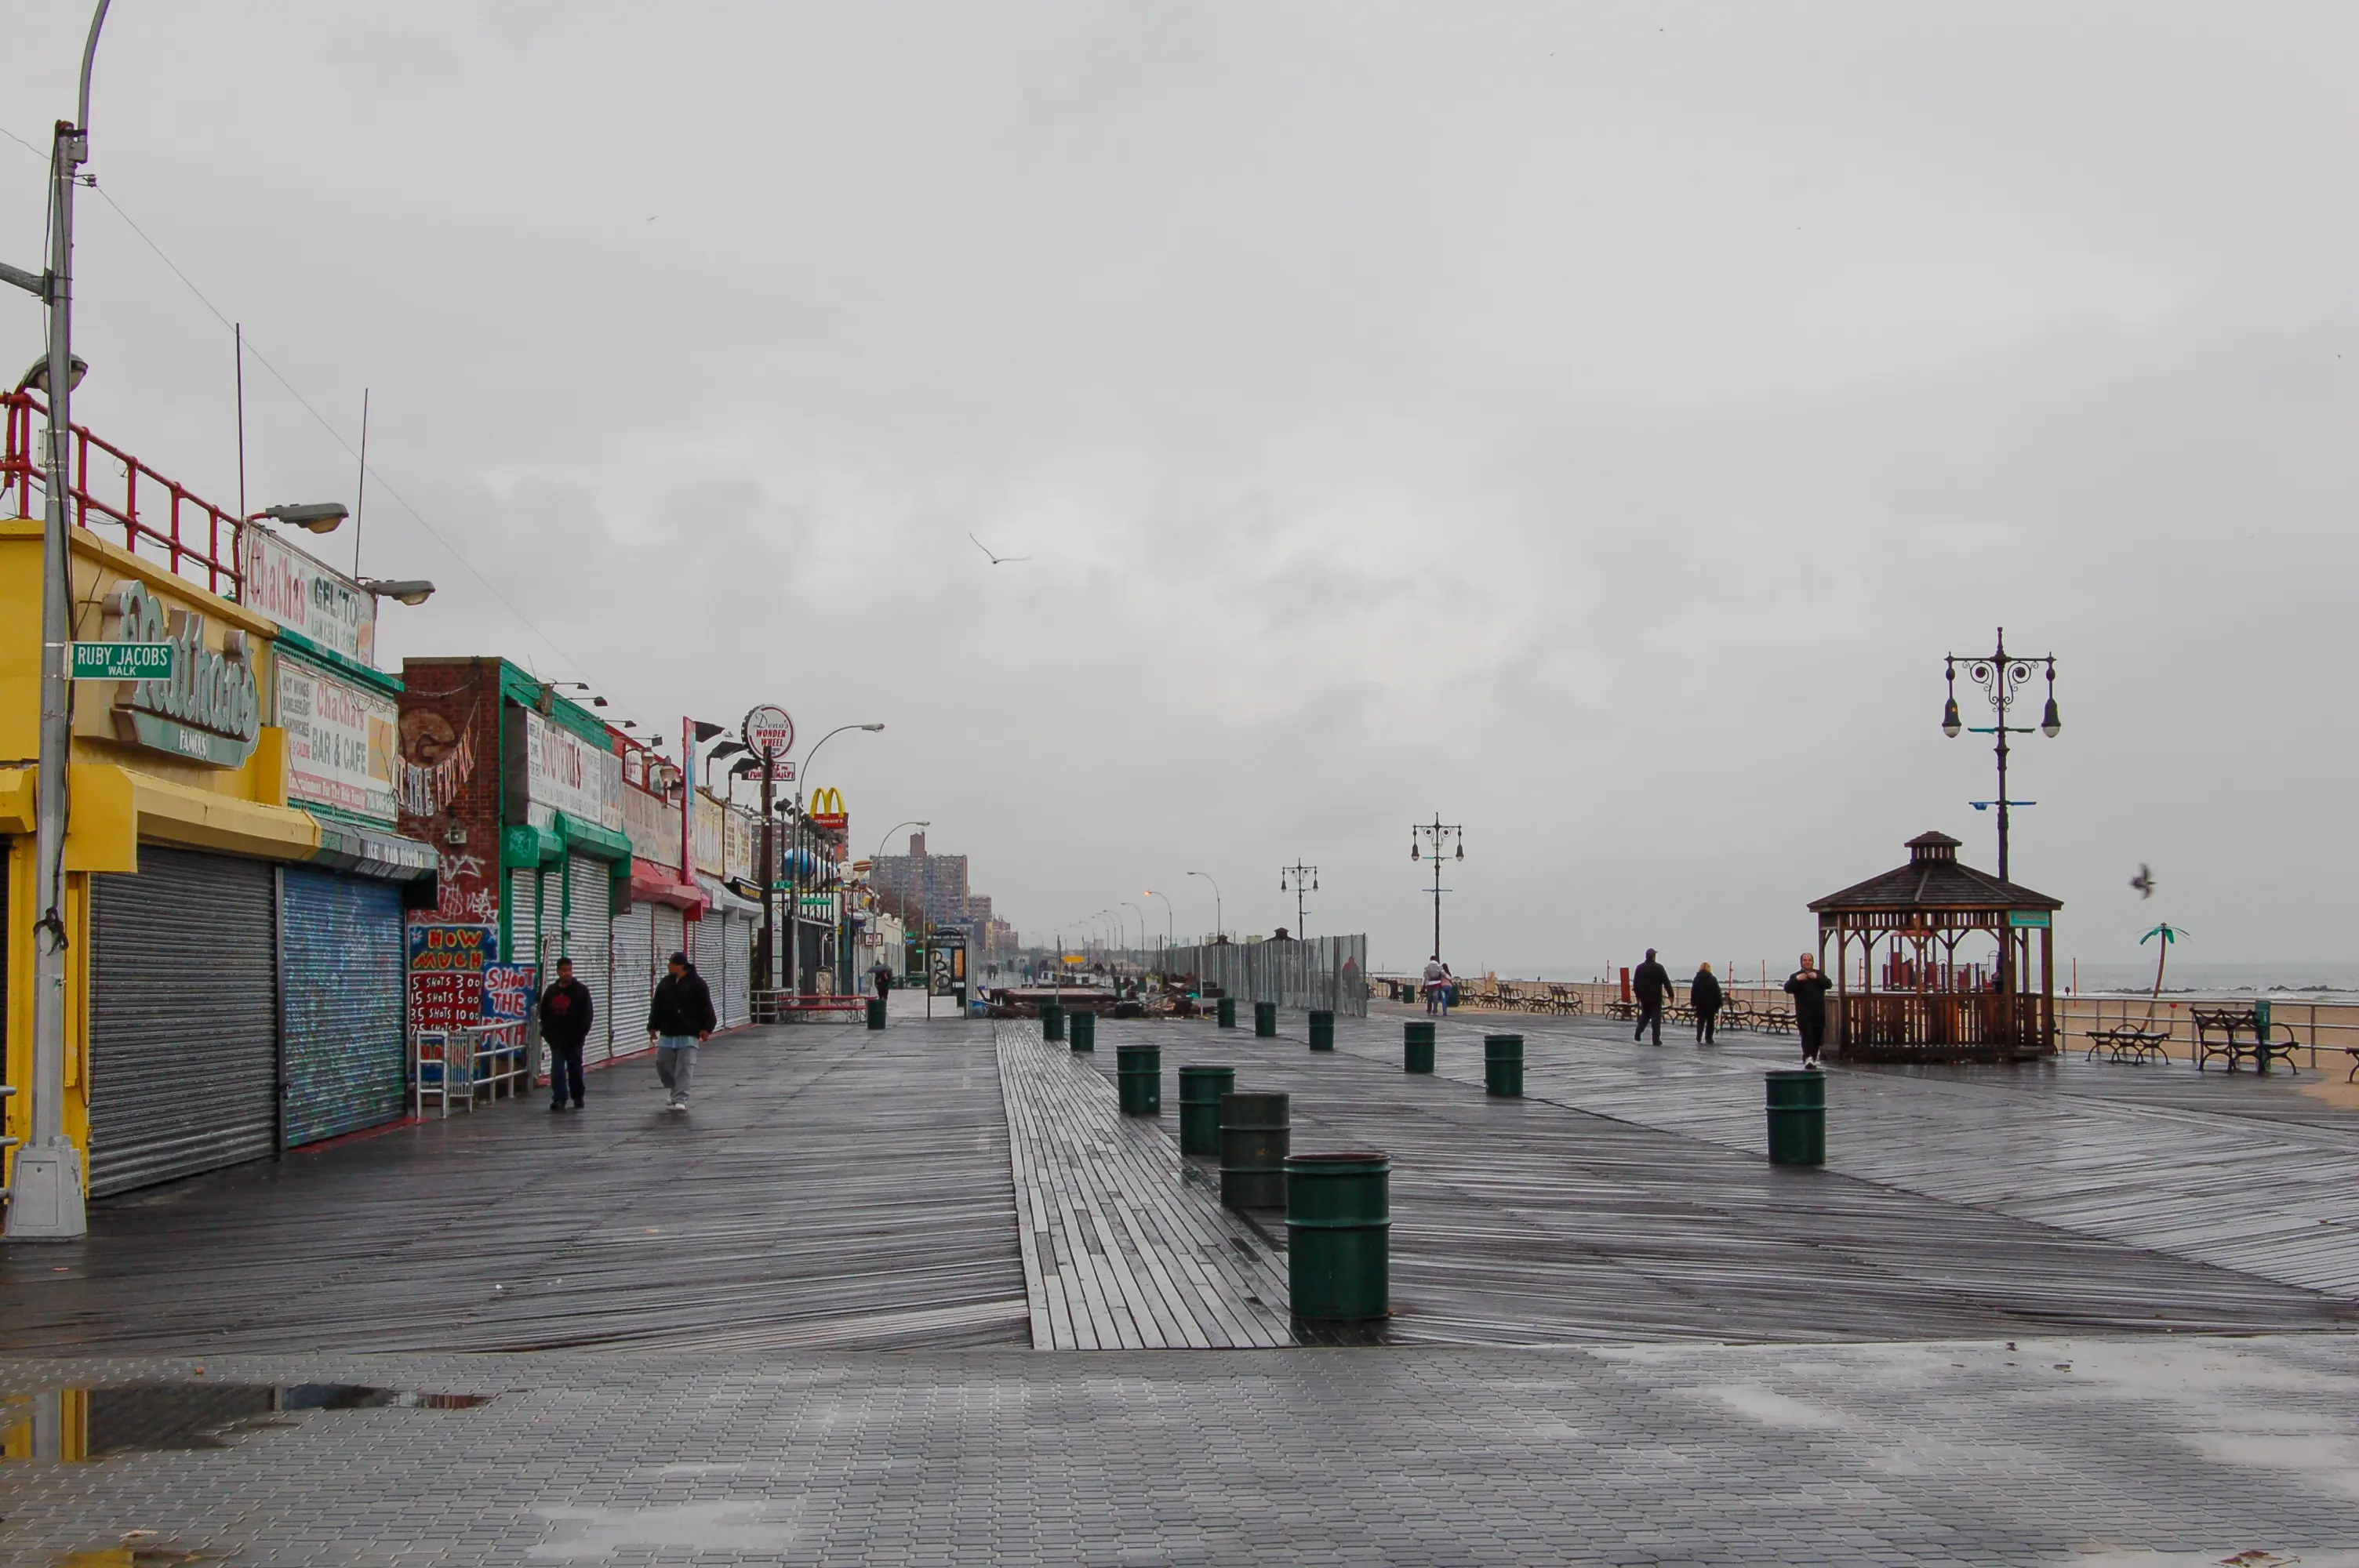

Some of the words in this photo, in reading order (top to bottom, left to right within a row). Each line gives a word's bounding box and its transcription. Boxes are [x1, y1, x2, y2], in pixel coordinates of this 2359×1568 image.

[314, 576, 358, 628] GELATO
[78, 646, 112, 665] RUBY
[117, 646, 168, 666] JACOBS
[108, 666, 136, 676] WALK
[753, 713, 789, 728] Deno's
[179, 728, 207, 757] FAMOUS
[756, 729, 787, 738] WONDER
[761, 738, 783, 747] WHEEL
[311, 727, 331, 765] BAR
[334, 733, 340, 768] &
[343, 737, 366, 775] CAFE
[408, 762, 435, 815] THE
[428, 929, 482, 949] HOW
[413, 951, 483, 970] MUCH
[413, 975, 421, 990] 5
[427, 976, 451, 988] SHOTS
[485, 967, 537, 991] SHOOT
[410, 990, 423, 1005] 15
[427, 991, 453, 1004] SHOTS
[488, 991, 527, 1017] THE
[410, 1007, 424, 1021] 35
[430, 1007, 451, 1020] SHOTS
